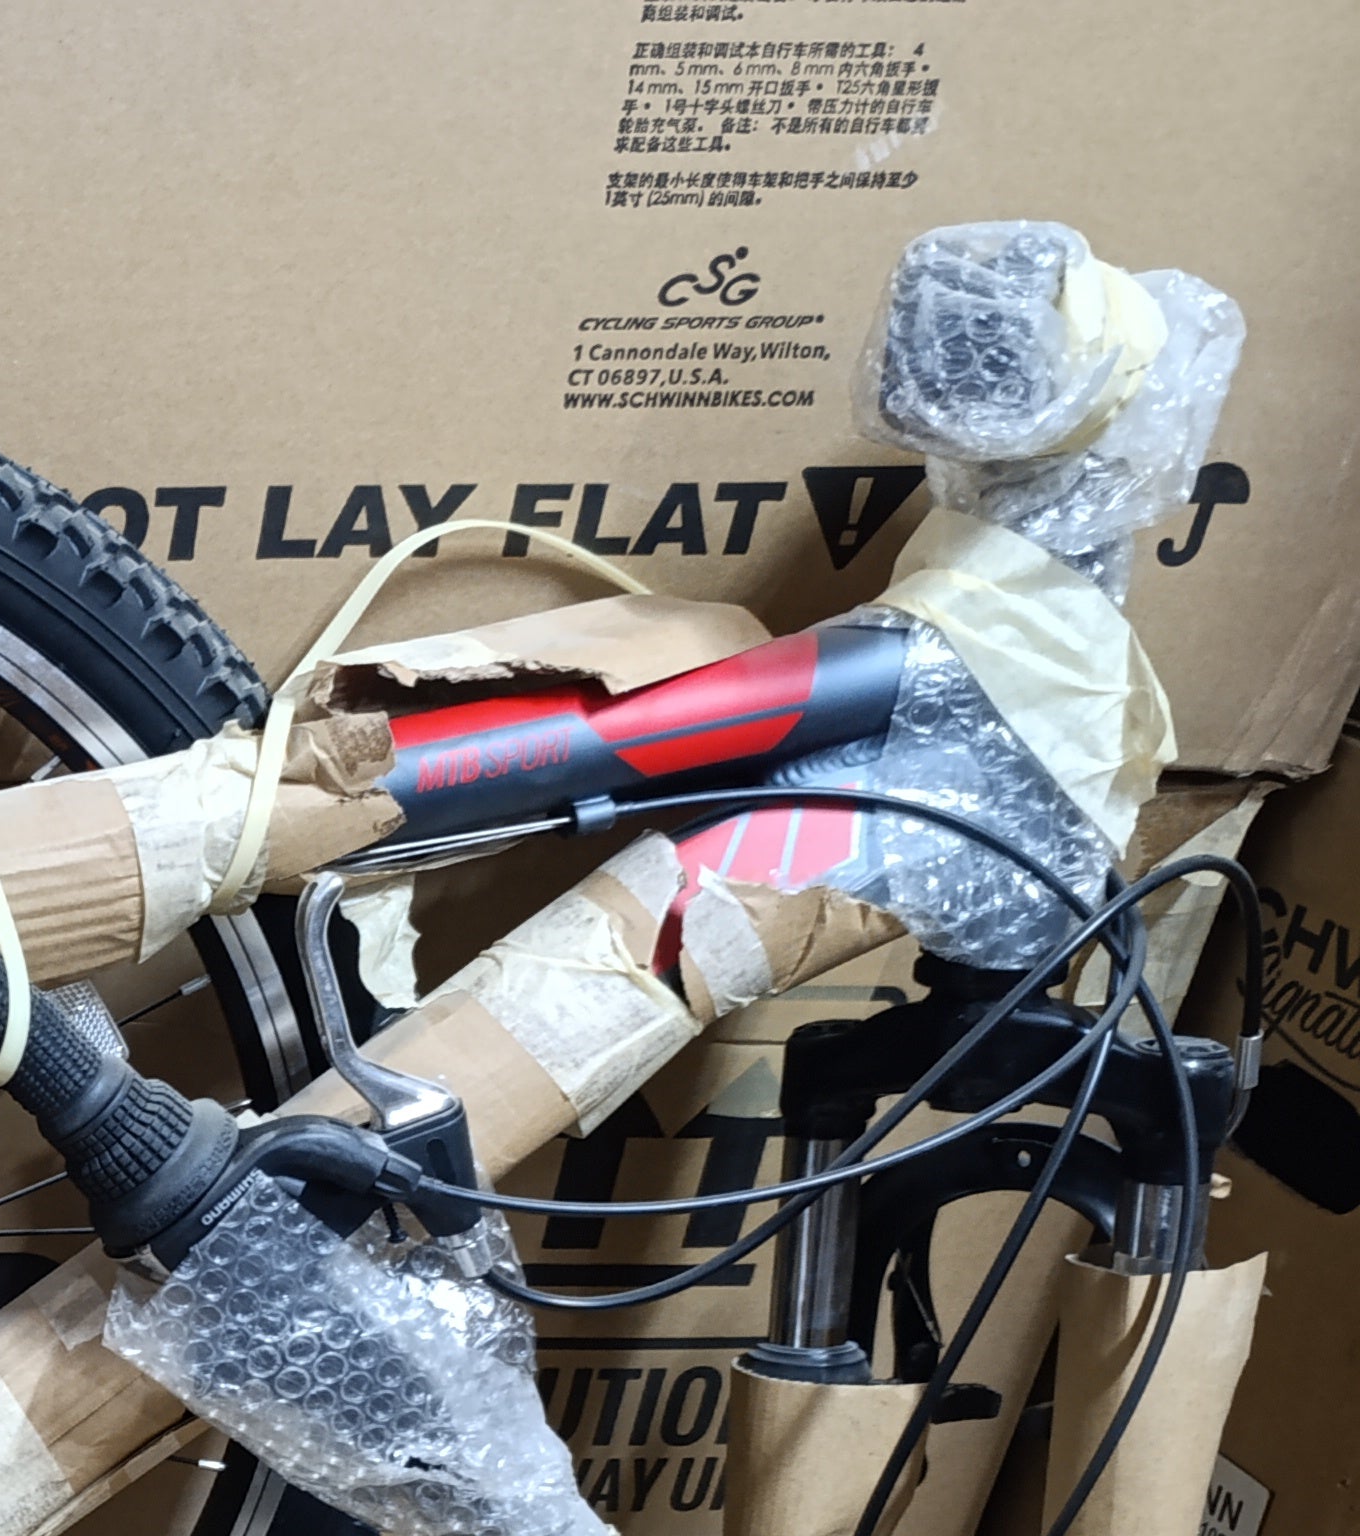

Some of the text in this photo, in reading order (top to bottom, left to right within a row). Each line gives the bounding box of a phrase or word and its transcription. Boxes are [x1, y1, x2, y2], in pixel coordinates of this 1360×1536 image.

[578, 317, 659, 331] CYCLING
[660, 316, 742, 330] SPORTS
[574, 345, 583, 361] 1
[589, 342, 707, 361] Cannondale
[568, 369, 594, 386] CT
[564, 390, 814, 409] WWW.SCHWINNBIKES.COM
[86, 481, 787, 560] OT LAY FLAT
[416, 728, 573, 792] MTB SPORT
